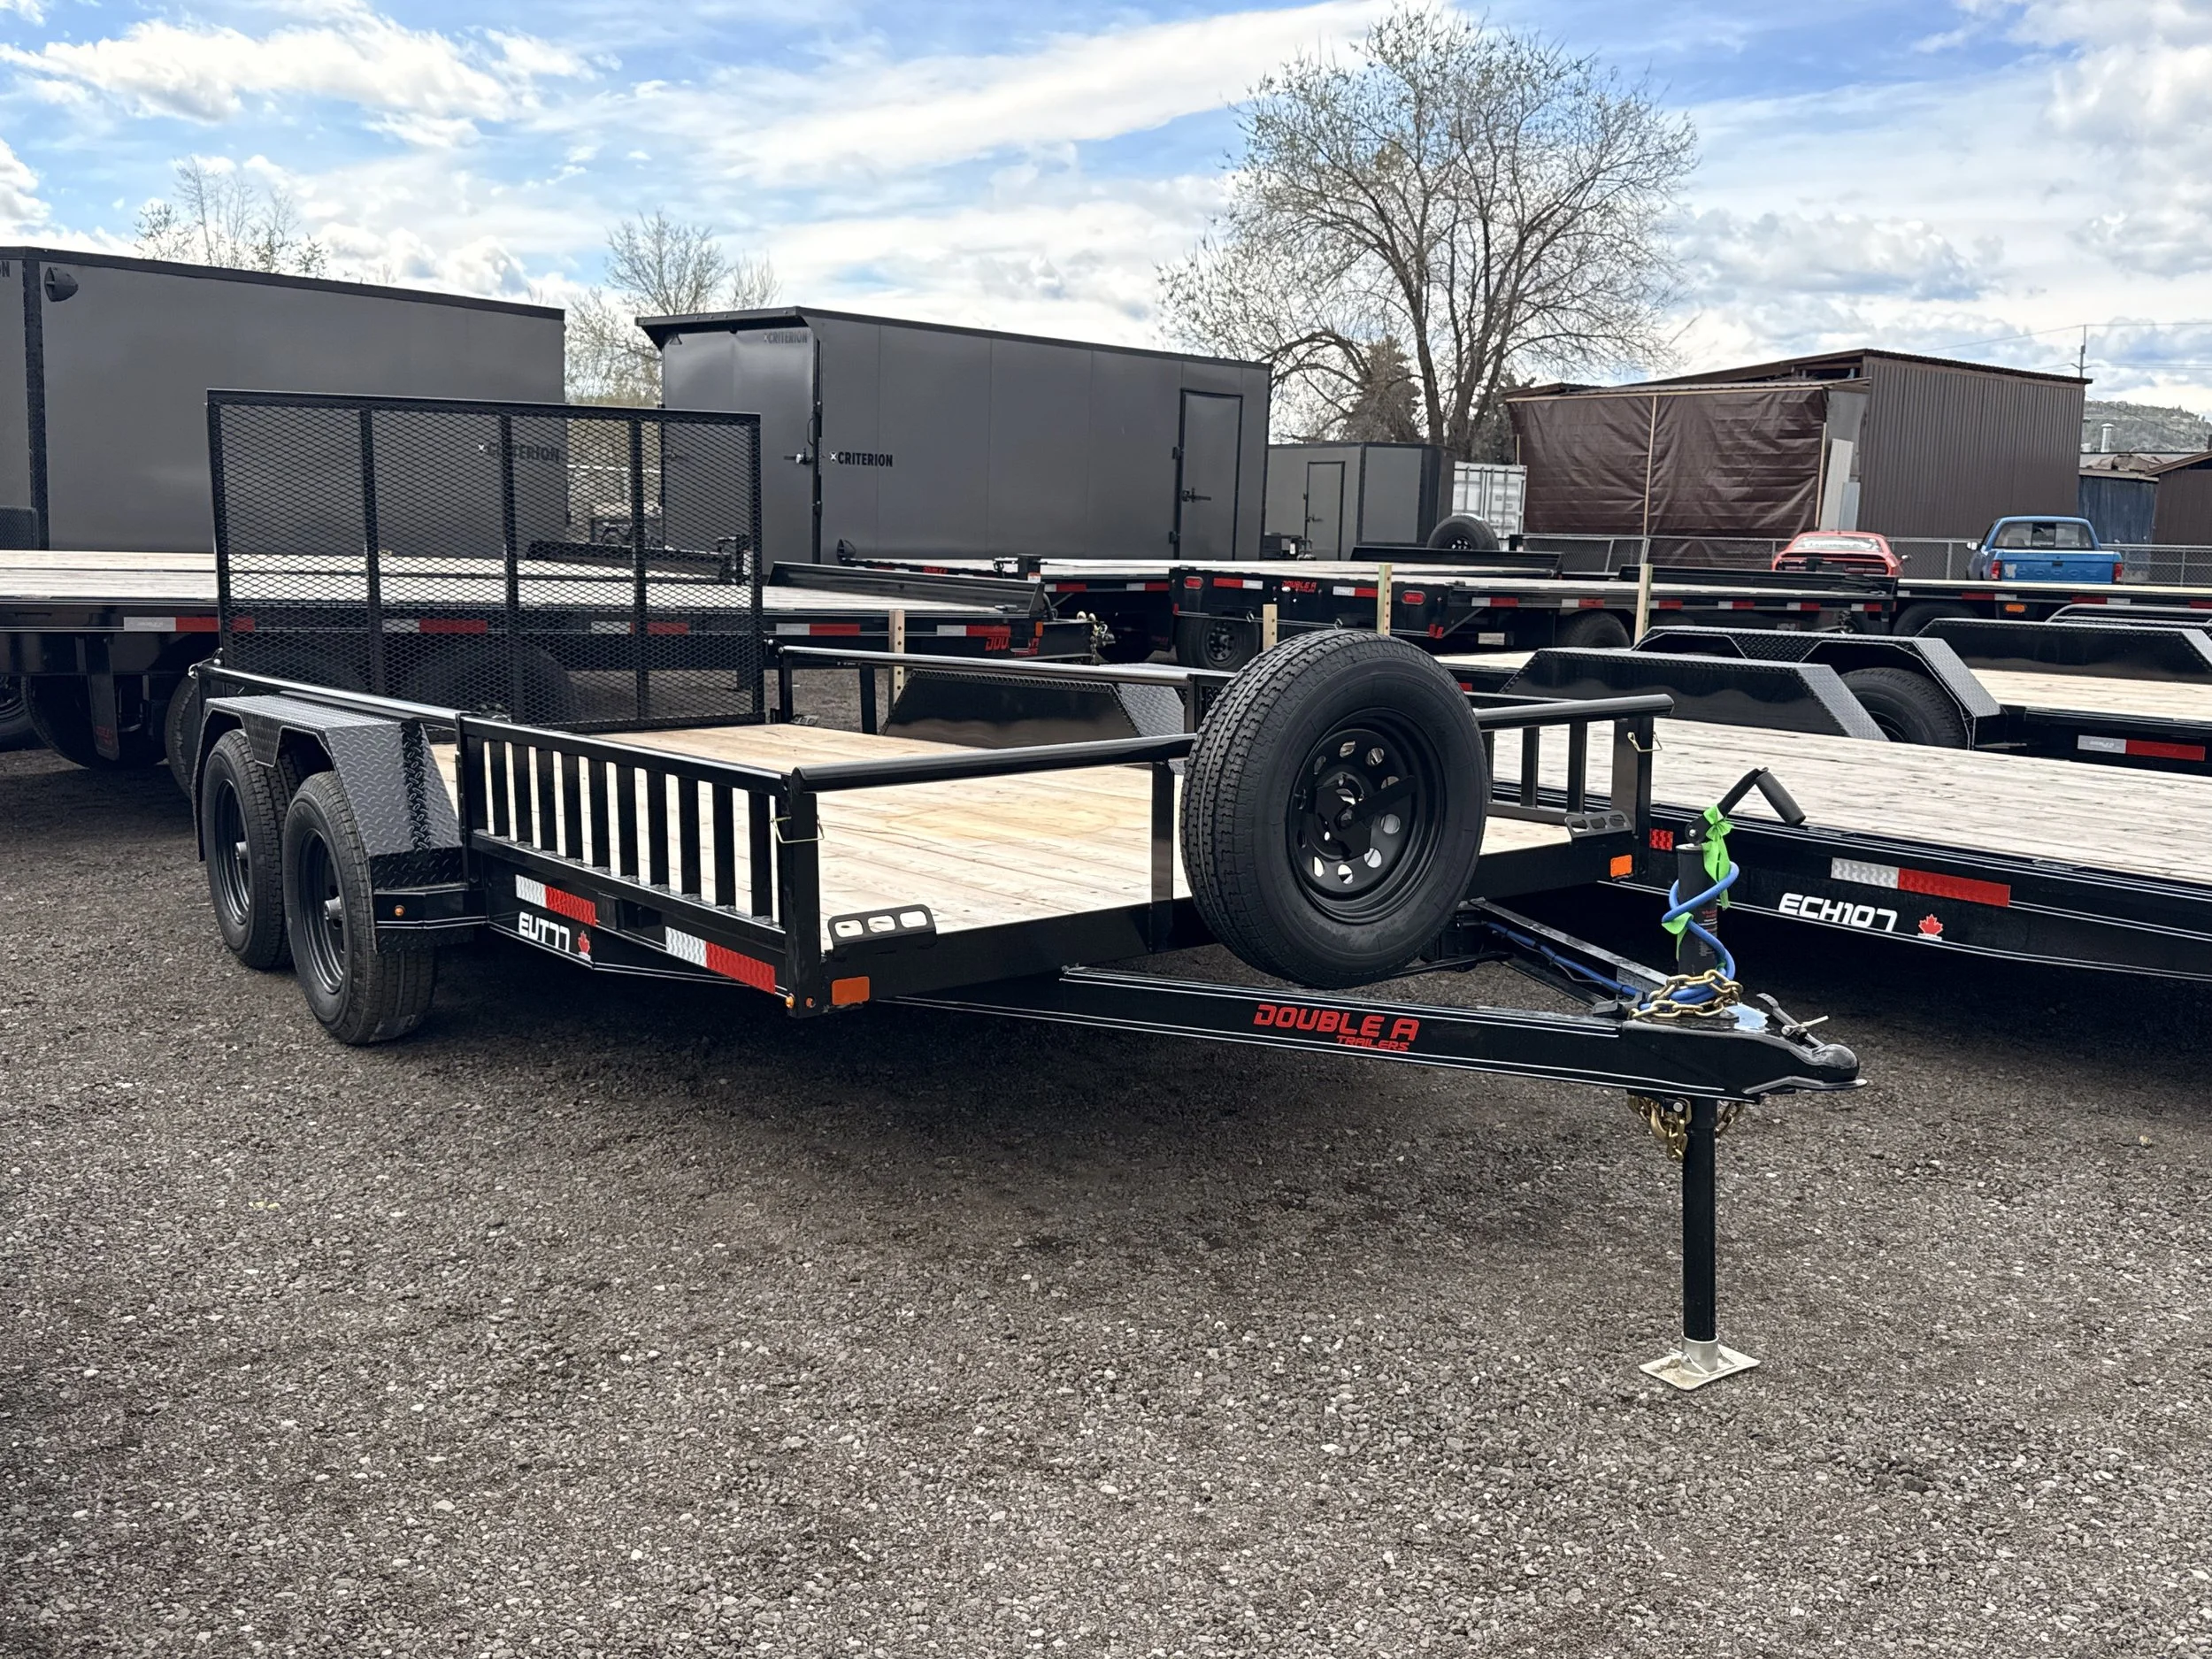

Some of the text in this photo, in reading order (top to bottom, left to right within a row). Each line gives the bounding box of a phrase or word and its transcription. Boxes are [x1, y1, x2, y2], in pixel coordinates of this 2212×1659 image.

[837, 451, 894, 467] CRITERION
[1778, 892, 1898, 933] ECH107
[518, 911, 571, 953] EUT77
[1253, 1004, 1419, 1041] DOUBLE A
[1336, 1034, 1409, 1052] TRAILERS
